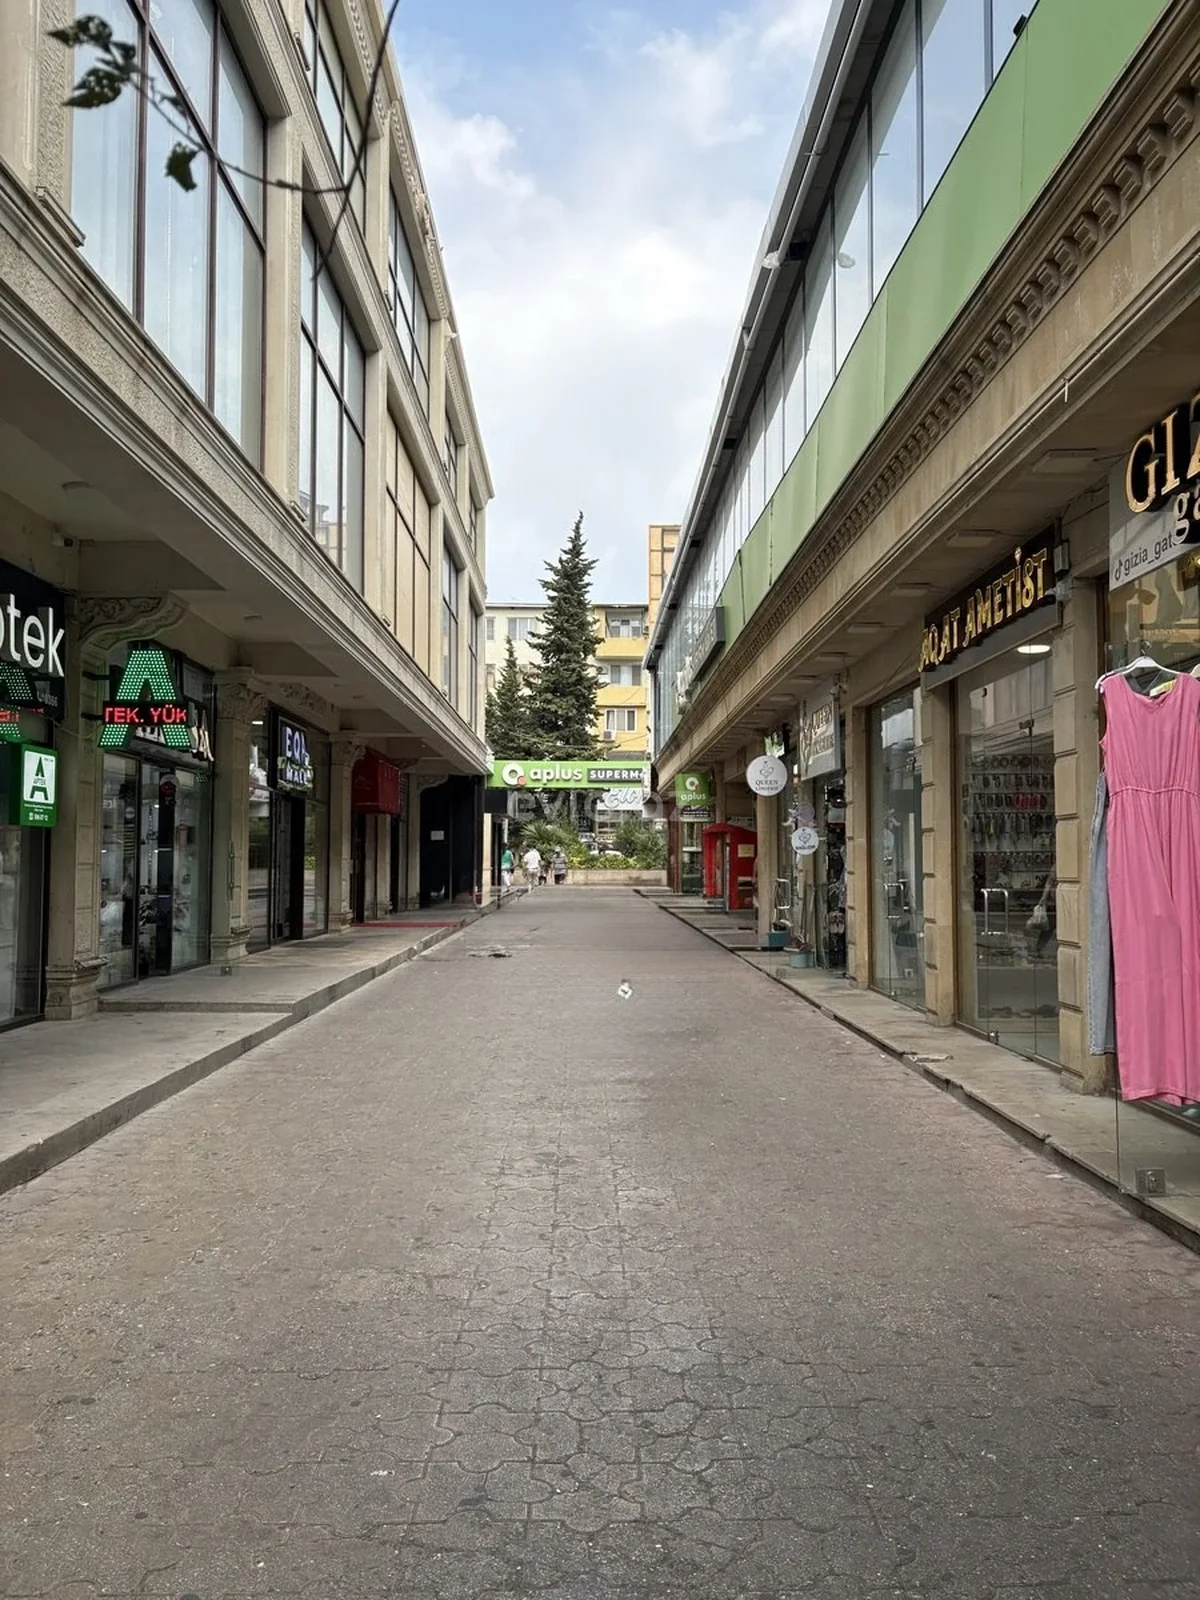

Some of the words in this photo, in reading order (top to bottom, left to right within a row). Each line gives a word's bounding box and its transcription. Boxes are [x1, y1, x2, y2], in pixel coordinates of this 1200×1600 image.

[1124, 531, 1178, 576] gizia_gat
[0, 593, 65, 678] tek
[529, 763, 582, 785] aplus
[680, 791, 706, 802] aplus
